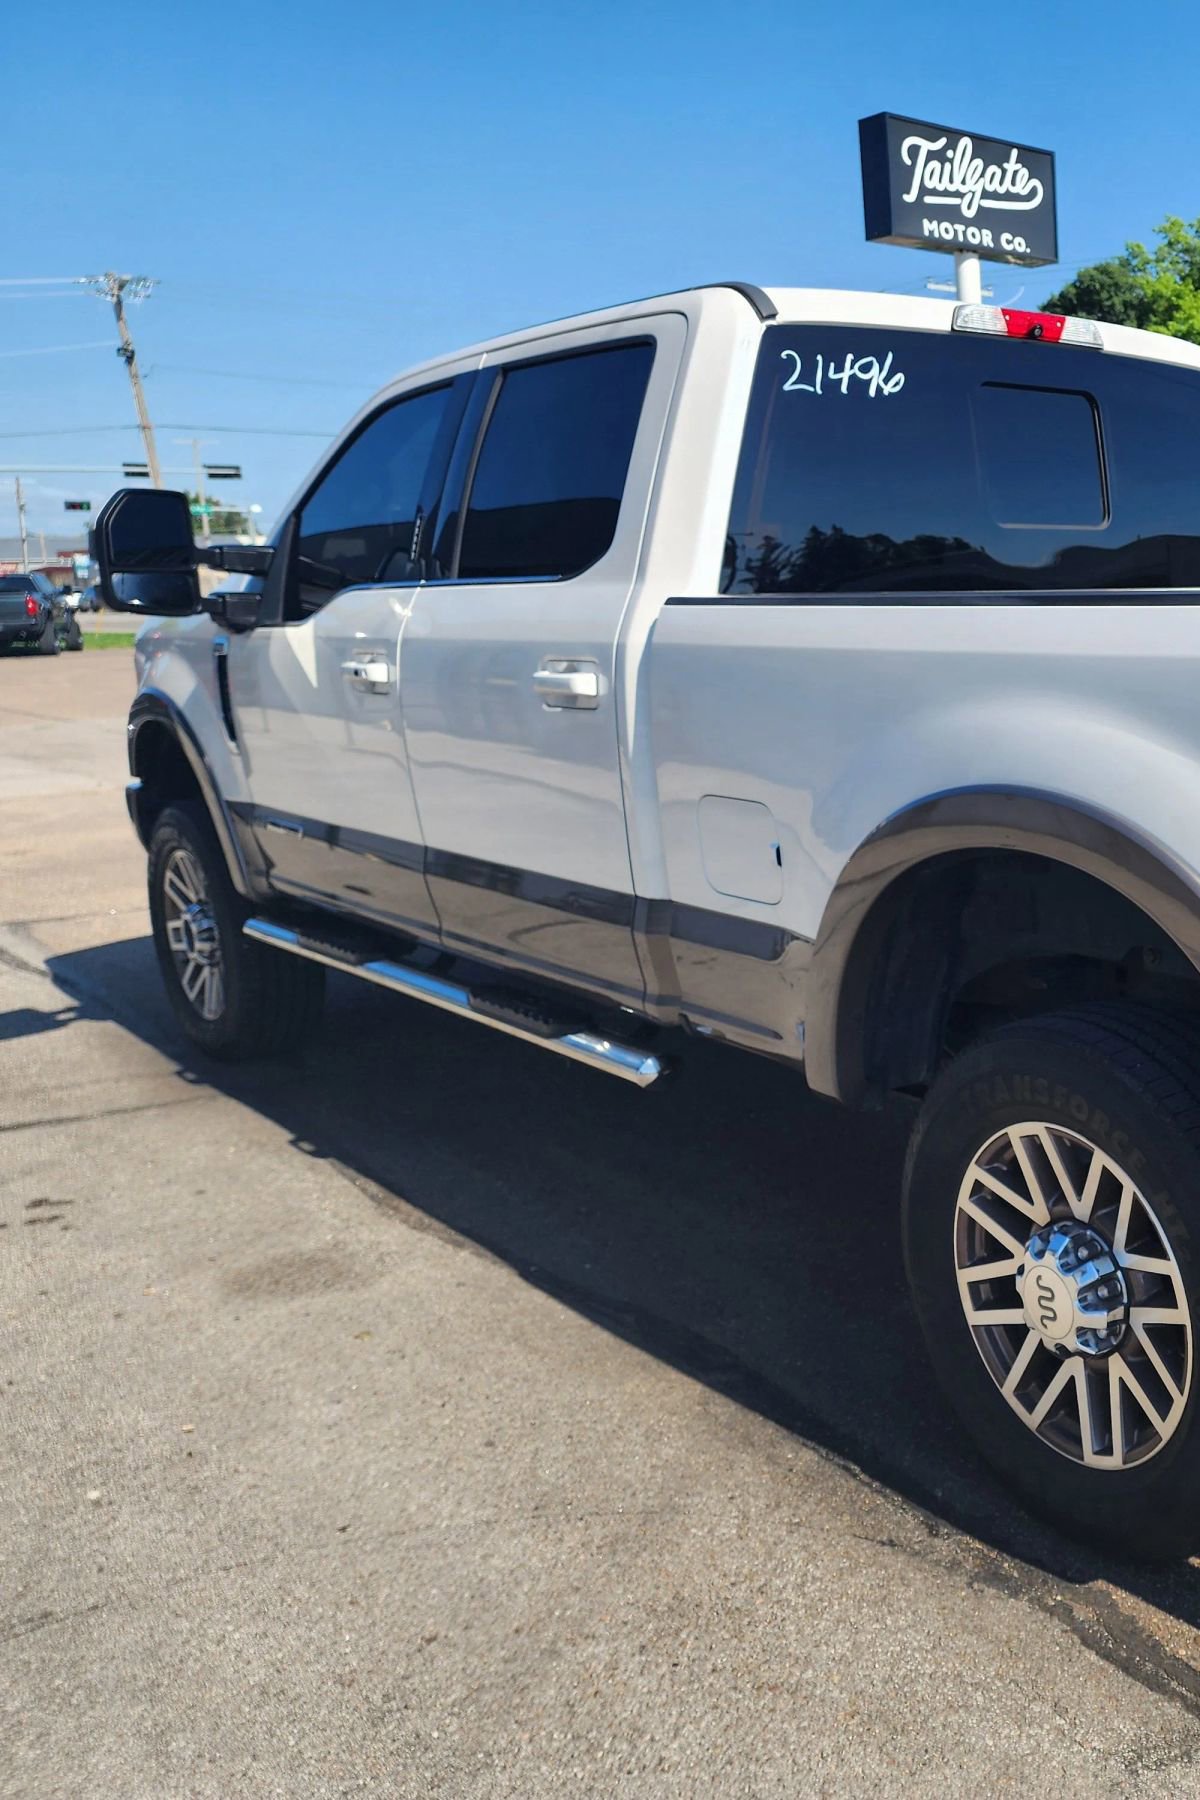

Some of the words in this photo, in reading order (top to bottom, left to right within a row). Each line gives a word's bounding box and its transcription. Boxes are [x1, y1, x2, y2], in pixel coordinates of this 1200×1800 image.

[901, 136, 1044, 218] Tailgate
[922, 218, 994, 248] MOTOR
[1000, 232, 1031, 253] CO.
[780, 349, 905, 398] 21496
